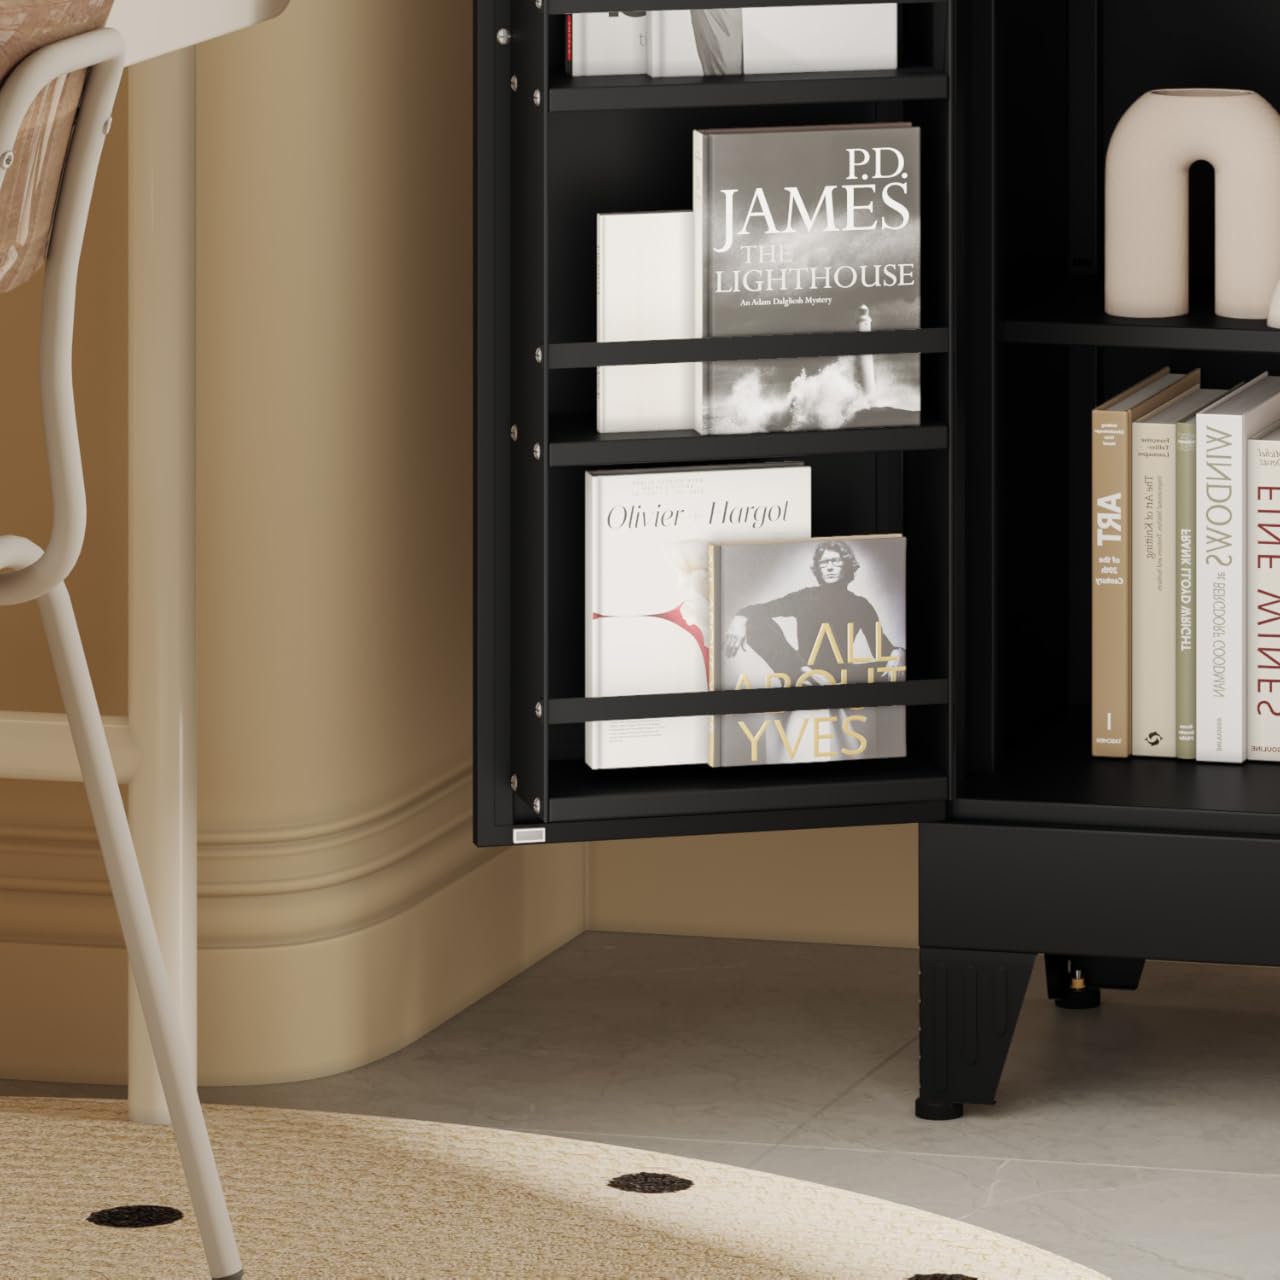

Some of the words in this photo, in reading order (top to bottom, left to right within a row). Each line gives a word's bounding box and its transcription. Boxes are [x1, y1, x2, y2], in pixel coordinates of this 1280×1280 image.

[845, 146, 909, 181] P.D.
[713, 181, 911, 253] JAMES
[740, 244, 793, 265] THE
[715, 263, 916, 294] LIGHTHOUSE
[740, 297, 751, 307] An
[751, 296, 771, 307] Adam
[804, 294, 833, 307] Mystery
[607, 503, 685, 529] Olivier
[807, 621, 900, 666] ALL
[737, 715, 869, 762] YVES
